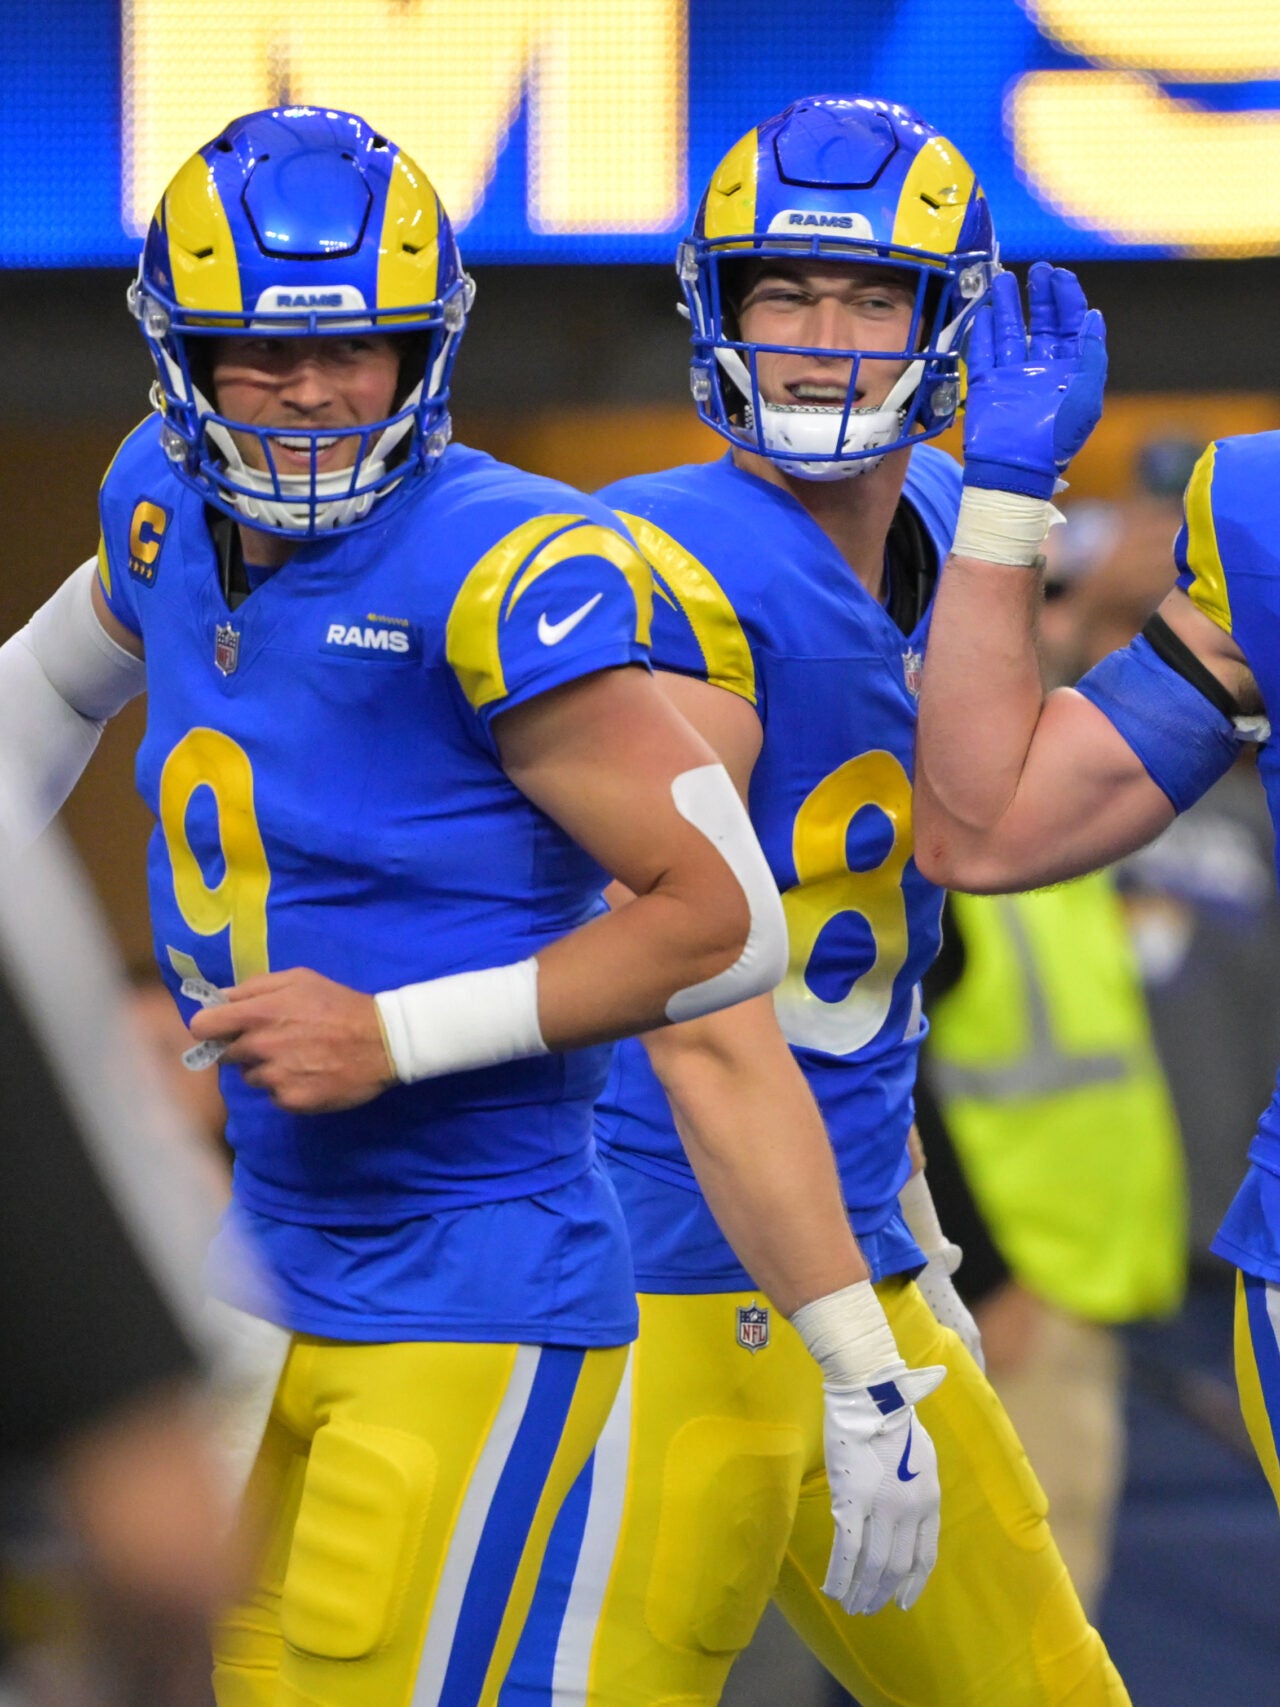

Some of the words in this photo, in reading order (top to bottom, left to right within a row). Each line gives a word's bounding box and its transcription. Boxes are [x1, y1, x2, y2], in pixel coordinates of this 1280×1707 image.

[789, 213, 854, 229] RAMS
[276, 294, 343, 307] RAMS
[130, 500, 166, 564] C
[326, 623, 410, 653] RAMS
[159, 726, 271, 990] 9
[742, 1324, 766, 1344] NFL
